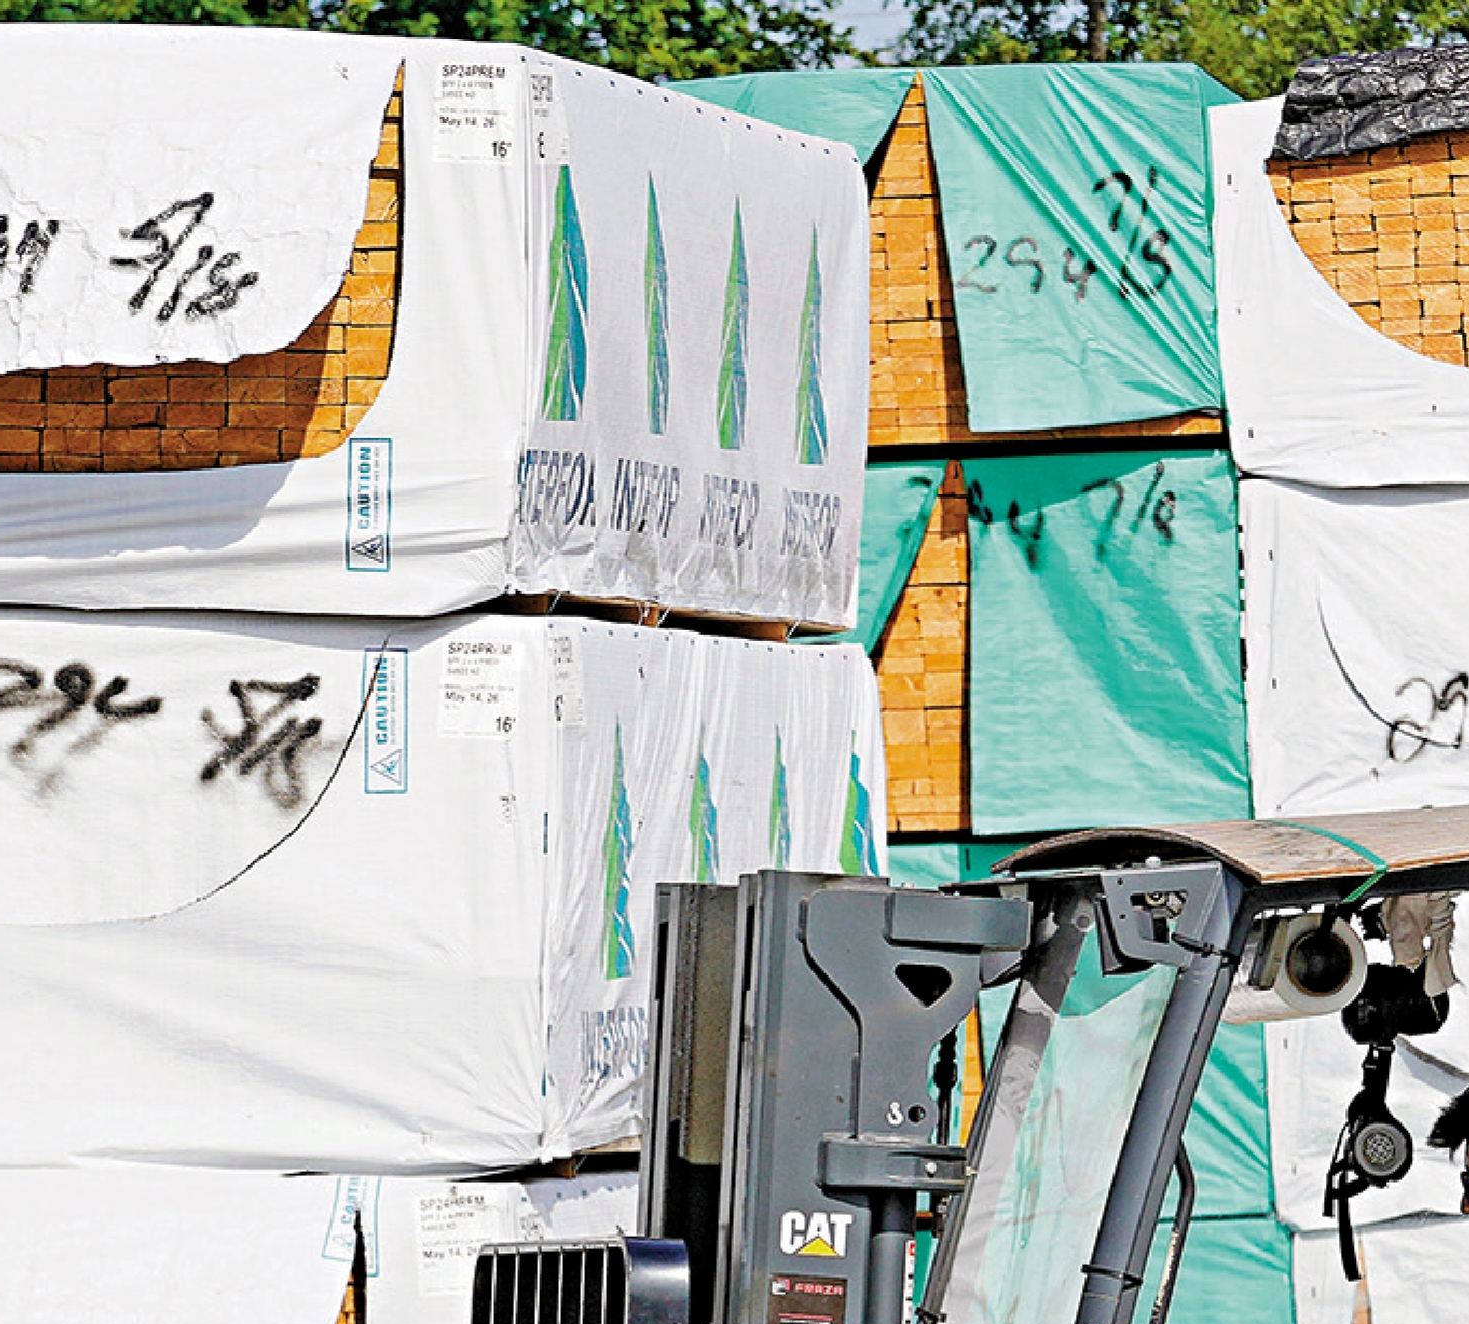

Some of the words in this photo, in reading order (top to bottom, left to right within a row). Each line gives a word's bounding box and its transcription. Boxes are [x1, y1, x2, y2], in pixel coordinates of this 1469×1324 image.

[957, 234, 1097, 302] 294
[358, 446, 371, 530] CAUTION
[375, 658, 389, 745] CAUTION
[780, 1210, 853, 1257] CAT
